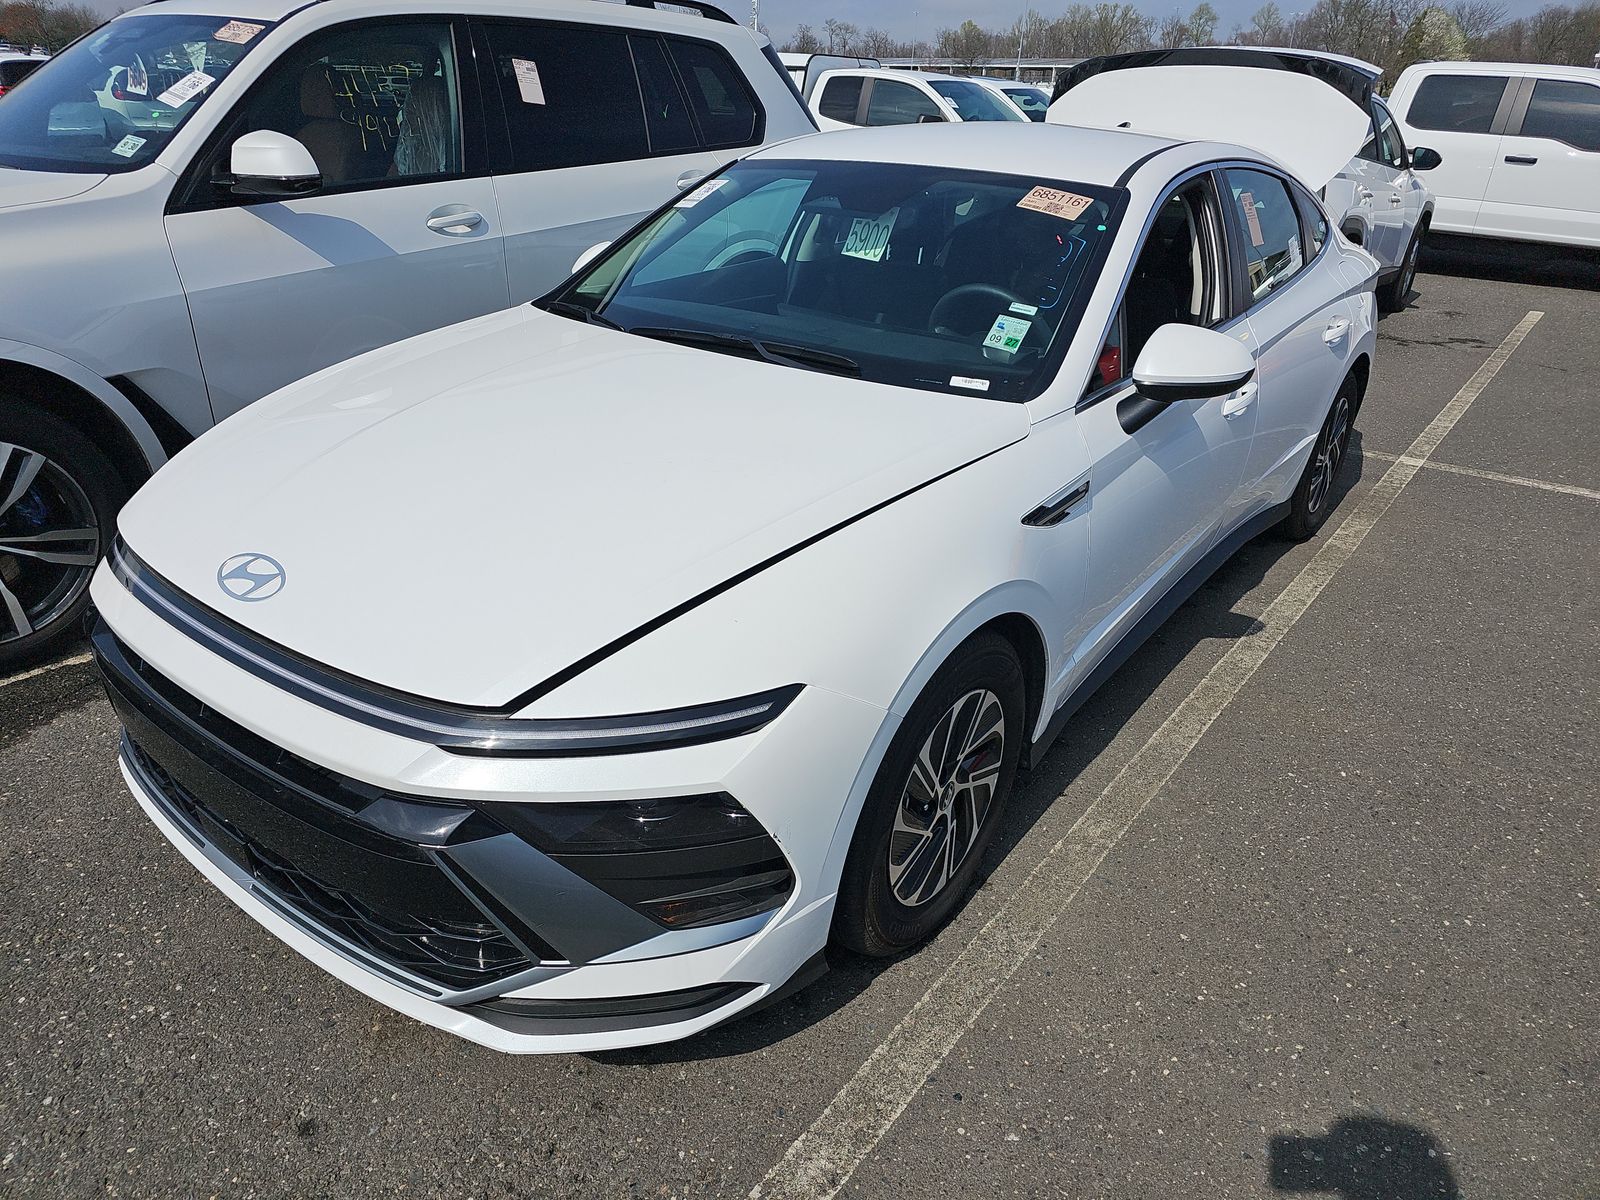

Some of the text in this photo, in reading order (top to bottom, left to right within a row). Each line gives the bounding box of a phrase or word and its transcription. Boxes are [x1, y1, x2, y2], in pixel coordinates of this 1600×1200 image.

[1032, 188, 1090, 209] 6851161
[846, 219, 890, 258] 5900
[990, 334, 1019, 347] 09 27
